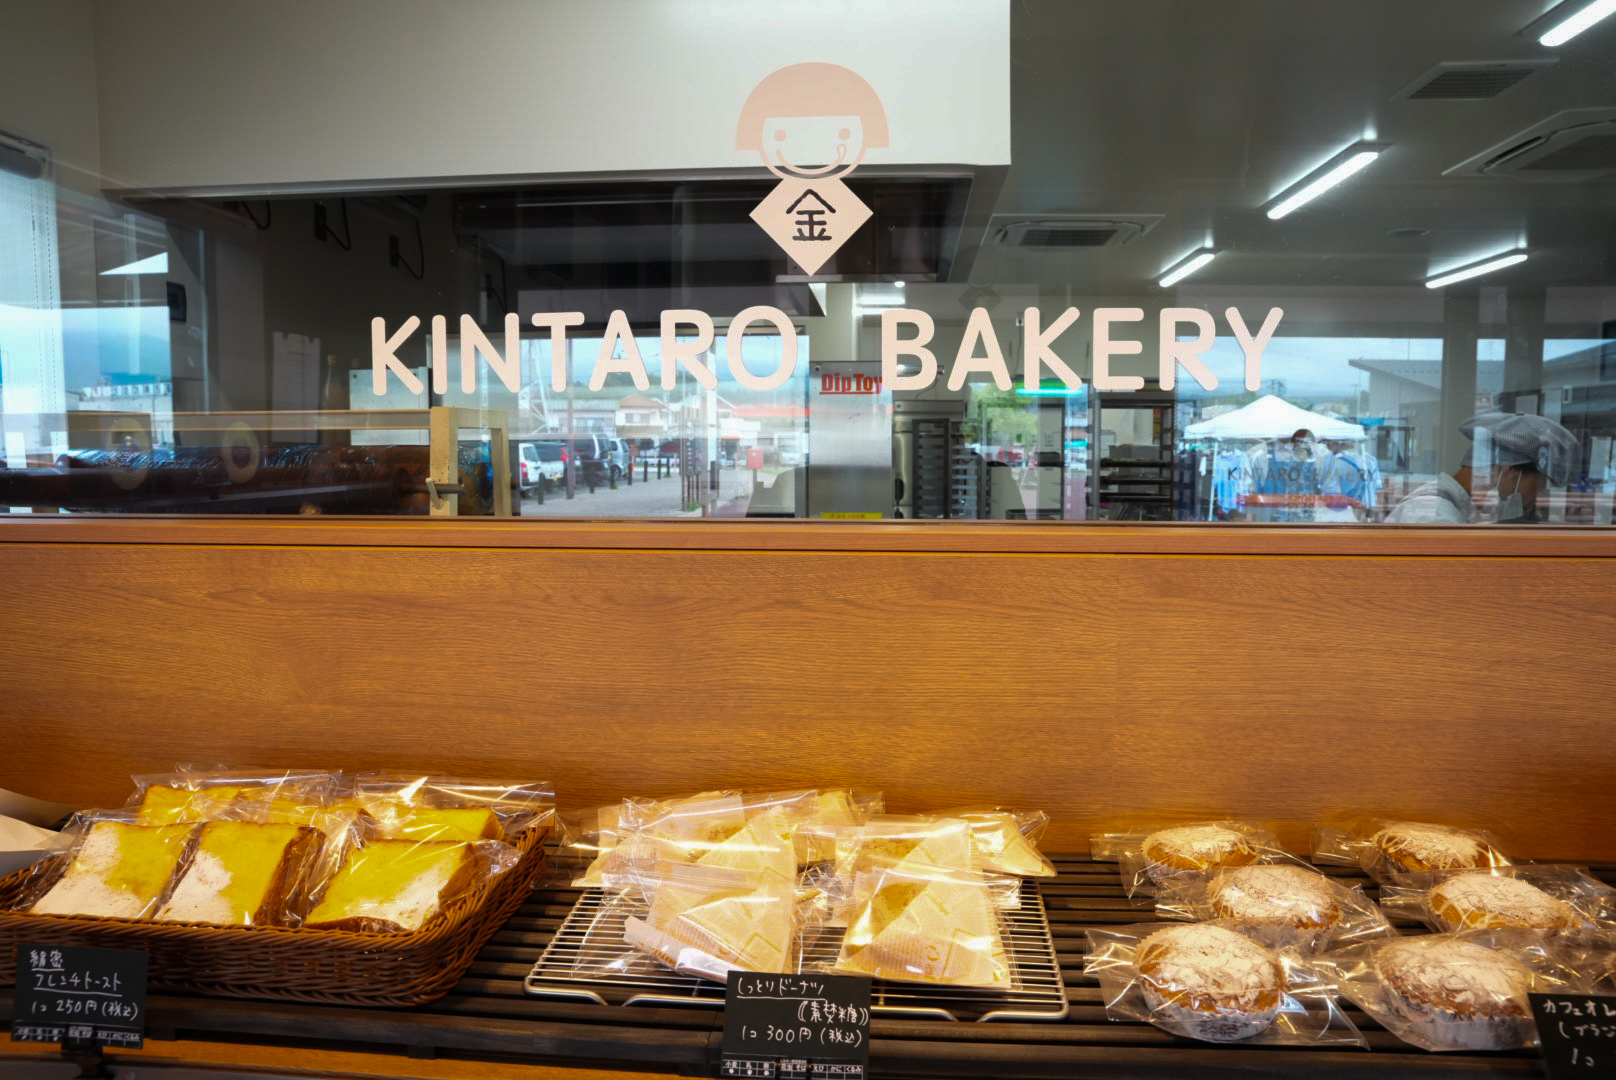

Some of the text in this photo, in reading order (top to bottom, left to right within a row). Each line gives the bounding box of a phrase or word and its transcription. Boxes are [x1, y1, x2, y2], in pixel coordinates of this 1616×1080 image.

[786, 188, 836, 241] 金
[370, 305, 1284, 397] KINTARO BAKERY
[738, 977, 824, 996] しっとりドーナツ
[766, 1024, 812, 1044] 300円
[820, 1027, 863, 1048] (税込)
